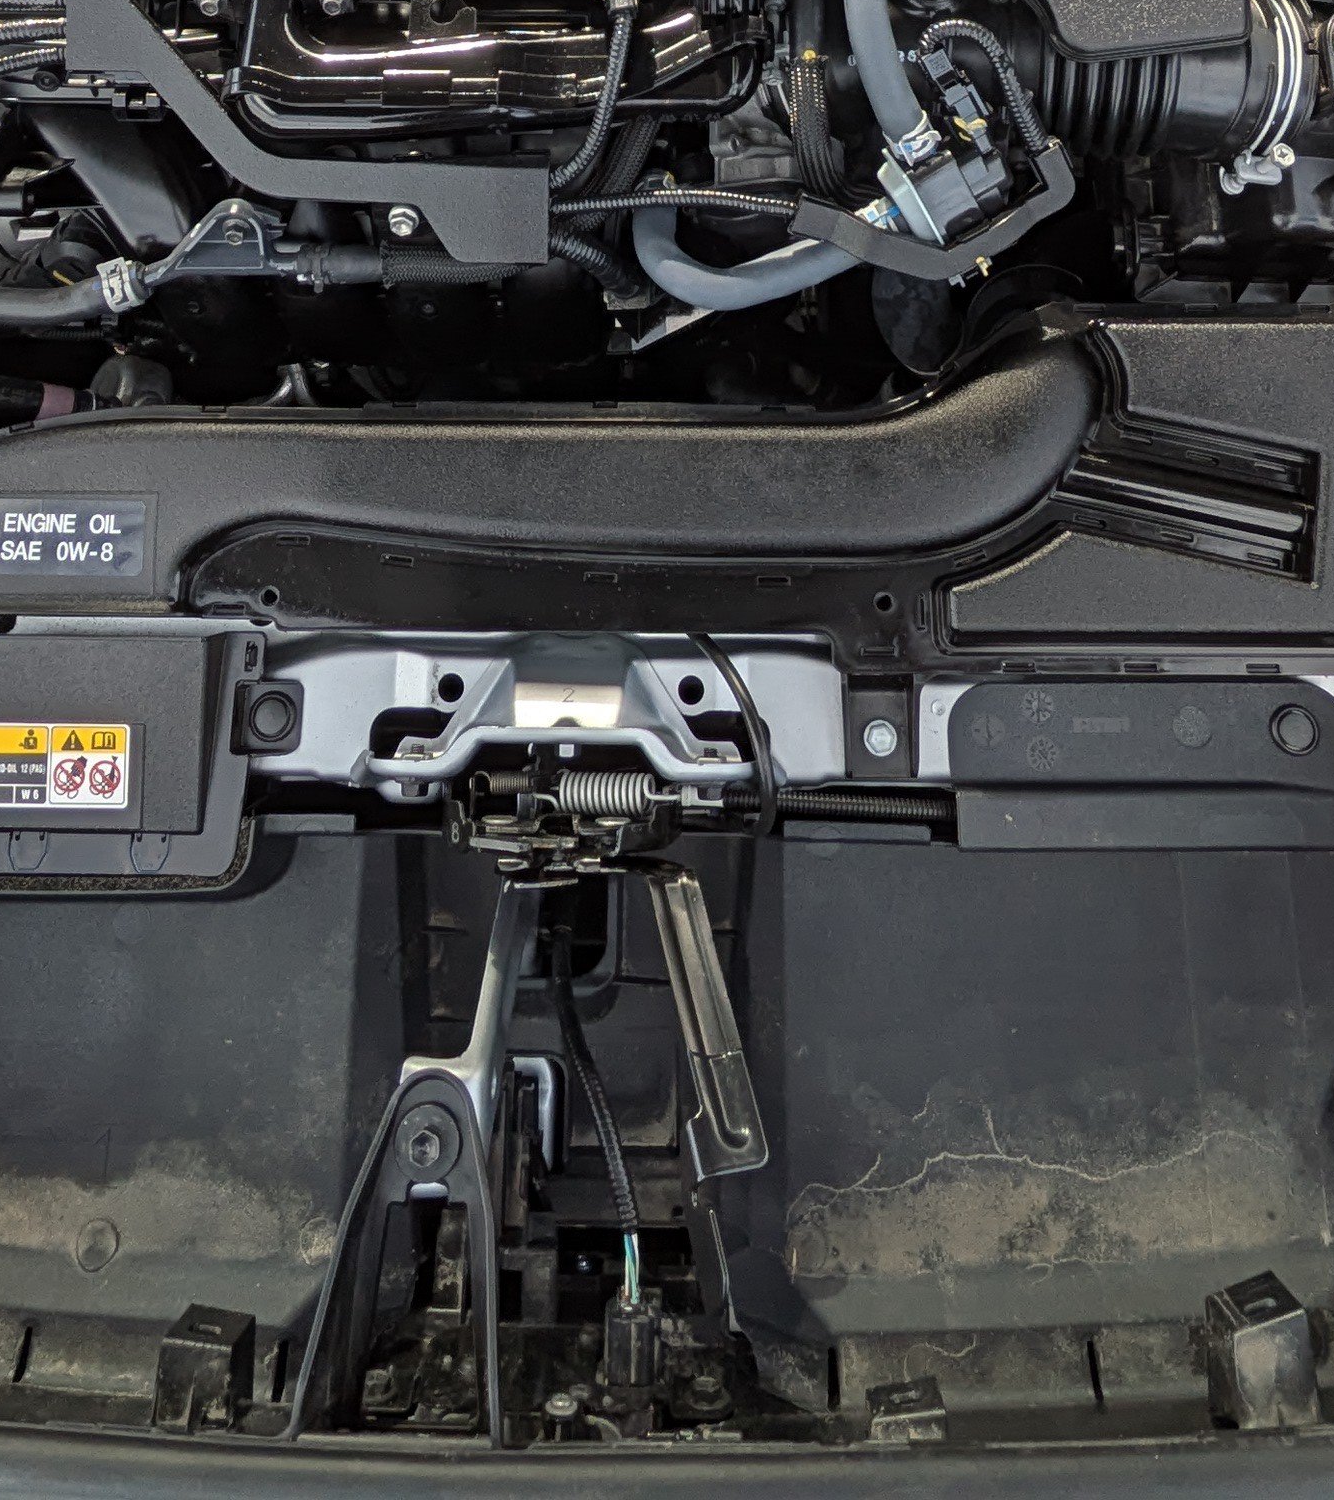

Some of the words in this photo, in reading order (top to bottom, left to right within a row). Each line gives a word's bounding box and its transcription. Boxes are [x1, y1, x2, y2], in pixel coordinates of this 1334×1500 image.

[3, 513, 77, 533] ENGINE
[89, 514, 122, 535] OIL
[0, 540, 43, 561] SAE
[56, 541, 114, 562] 0W-8
[562, 688, 575, 703] 2
[21, 763, 29, 773] 12
[21, 790, 31, 800] W
[33, 790, 39, 799] 6
